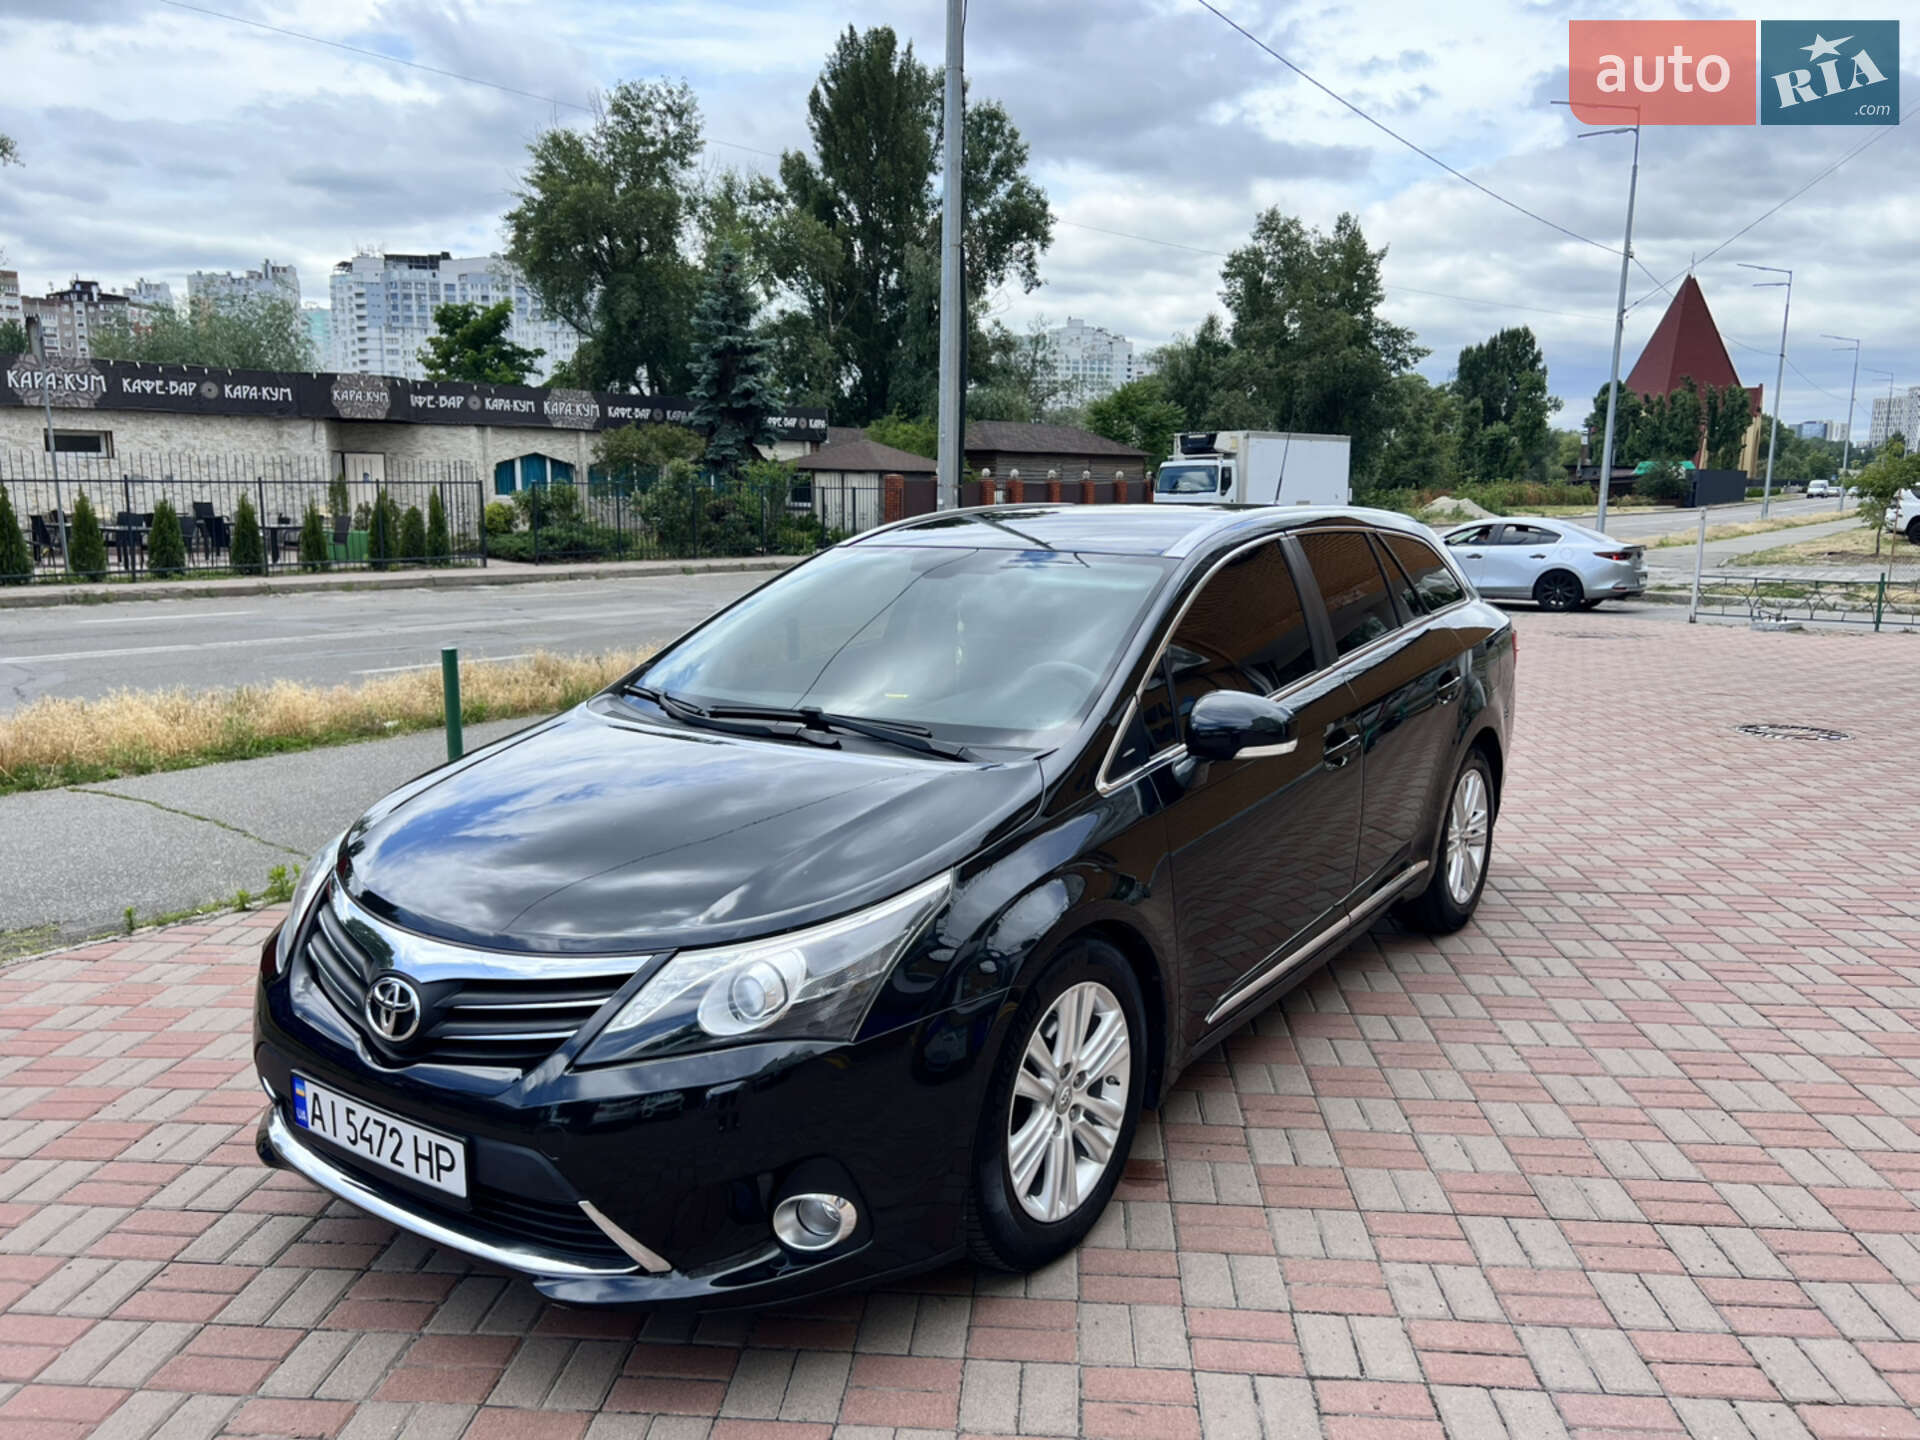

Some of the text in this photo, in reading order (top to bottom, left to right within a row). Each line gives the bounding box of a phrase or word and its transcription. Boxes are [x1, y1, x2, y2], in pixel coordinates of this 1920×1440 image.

[310, 1092, 456, 1183] AI 5472 HP
